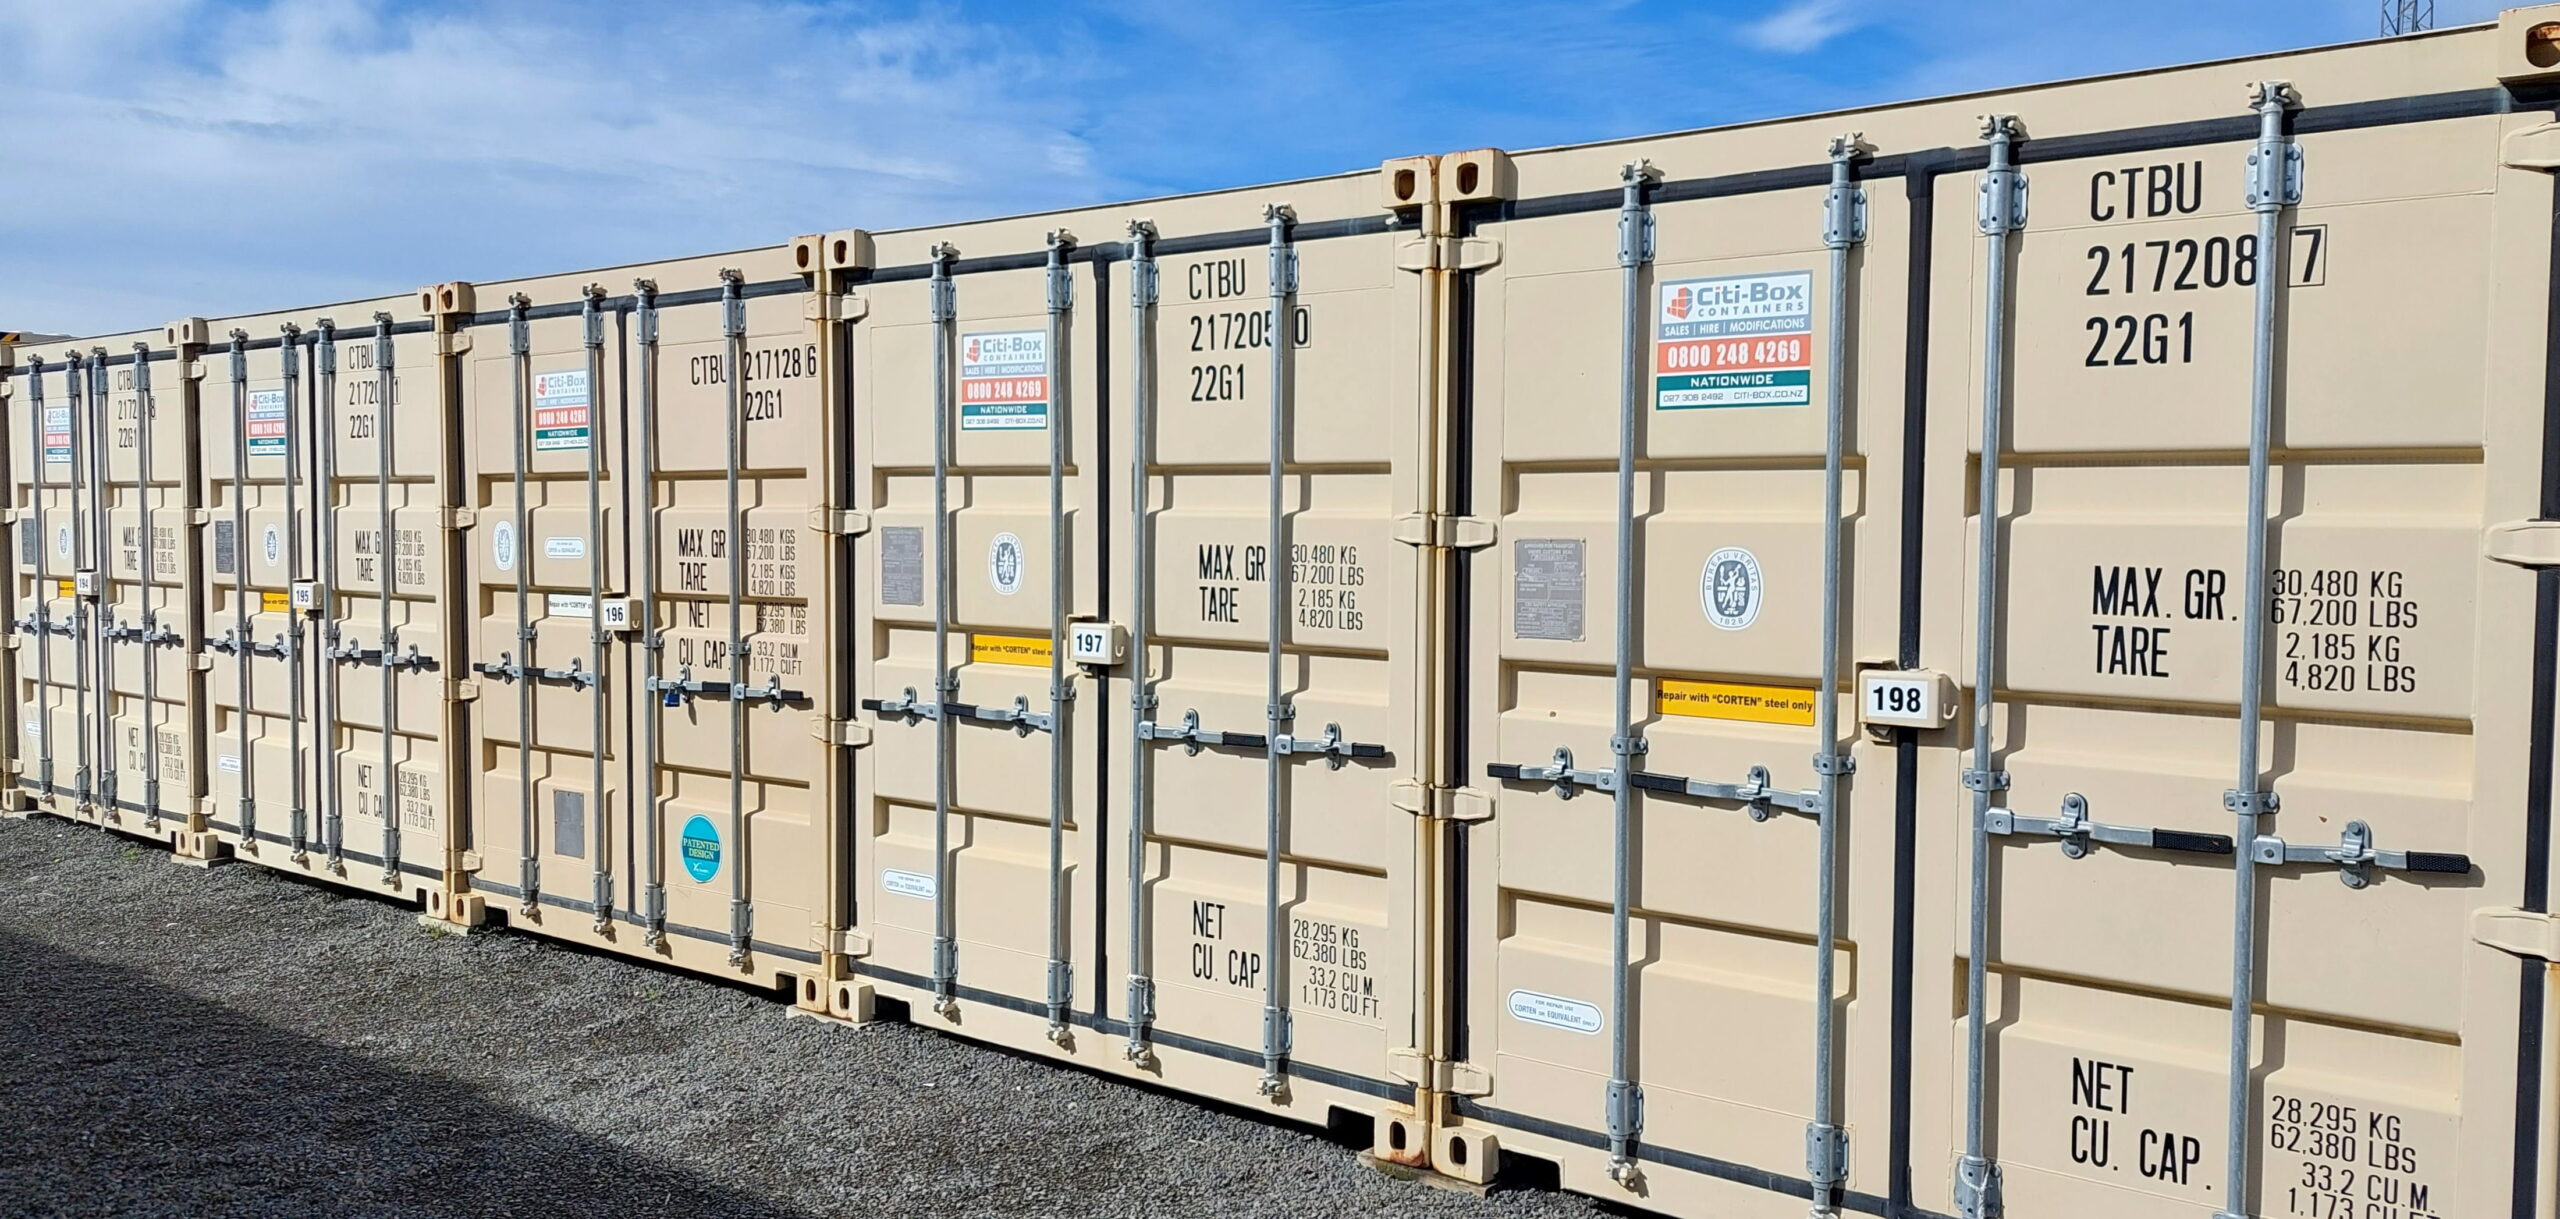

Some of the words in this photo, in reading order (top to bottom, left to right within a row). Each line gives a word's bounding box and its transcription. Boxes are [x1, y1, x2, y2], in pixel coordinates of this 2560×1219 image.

[2090, 160, 2202, 222] CTBU
[2086, 234, 2258, 296] 217208
[2295, 228, 2322, 283] 7
[1189, 258, 1246, 300] CTBU
[1697, 282, 1803, 306] Citi-Box
[1698, 302, 1804, 317] CONTAINERS
[1665, 325, 1689, 336] SALES
[1699, 323, 1719, 335] HIRE
[1729, 318, 1805, 332] MODIFICATIONS
[983, 337, 1042, 353] Citi-Box
[2085, 311, 2193, 367] 22G1
[349, 344, 374, 369] CTBU
[691, 354, 726, 385] CTBU
[744, 347, 800, 380] 217128
[807, 345, 816, 376] 6
[983, 353, 1043, 362] CONTAINERS
[1667, 344, 1711, 368] 0800
[1716, 342, 1749, 366] 248
[1755, 339, 1801, 363] 4269
[394, 379, 399, 403] 1
[548, 375, 586, 388] Citi-Box
[967, 382, 992, 399] 0800
[994, 381, 1012, 398] 248
[1016, 380, 1042, 398] 4269
[1191, 363, 1244, 402] 22G1
[1690, 374, 1774, 388] NATIONWIDE
[745, 389, 782, 421] 22G1
[1663, 394, 1680, 403] 027
[1734, 389, 1804, 400] CITI-BOX.CO.NZ
[980, 405, 1027, 414] NATIONWIDE
[350, 414, 374, 438] 22G1
[547, 429, 578, 438] NATIONWIDE
[118, 428, 137, 448] 22G1
[679, 529, 707, 557] MAX.
[780, 529, 796, 544] KGS
[123, 550, 137, 571] TARE
[414, 543, 425, 556] LBS
[780, 545, 796, 561] LBS
[1340, 546, 1357, 565] KG
[356, 558, 374, 581] TARE
[780, 564, 796, 580] KGS
[1199, 544, 1239, 581] MAX.
[1706, 553, 1729, 591] BUREAU
[1733, 552, 1758, 592] VERITAS
[414, 572, 425, 586] LBS
[679, 562, 707, 591] TARE
[1339, 566, 1364, 586] LBS
[2271, 569, 2358, 597] 30,480
[2370, 570, 2403, 598] KG
[296, 590, 309, 602] 195
[780, 581, 796, 597] LBS
[1339, 590, 1355, 609] KG
[2092, 565, 2172, 619] MAX.
[2184, 568, 2238, 622] GR.
[606, 607, 623, 621] 196
[689, 600, 711, 628] NET
[791, 603, 807, 619] KGS
[1199, 586, 1239, 623] TARE
[2271, 597, 2357, 627] 67,200
[2369, 600, 2418, 629] LBS
[790, 619, 807, 635] LBS
[1339, 611, 1363, 630] LBS
[1032, 648, 1046, 656] steel
[1076, 633, 1102, 652] 197
[2092, 624, 2171, 678] TARE
[2286, 631, 2355, 661] 2,185
[2368, 633, 2400, 662] KG
[2285, 661, 2355, 692] 4,820
[2367, 664, 2416, 693] LBS
[1657, 689, 1686, 701] Repair
[1689, 692, 1709, 703] with
[1764, 698, 1789, 709] steel
[1791, 701, 1813, 713] only
[1873, 686, 1921, 712] 198
[128, 727, 138, 748] NET
[358, 763, 372, 789] NET
[420, 787, 430, 801] LBS
[683, 837, 719, 851] PATENTED
[688, 847, 714, 860] DESIGN
[1193, 900, 1225, 940] NET
[1342, 927, 1358, 948] KG
[1193, 943, 1218, 982] CU.
[1228, 949, 1266, 991] CAP.
[1342, 948, 1367, 970] LBS
[1309, 965, 1336, 989] 33.2
[1514, 1003, 1537, 1015] CORTEN
[1547, 1010, 1581, 1024] EQUIVALENT
[2072, 1057, 2134, 1115] NET
[2369, 1111, 2401, 1143] KG
[2071, 1114, 2119, 1171] CU.
[2139, 1128, 2212, 1191] CAP.
[2368, 1140, 2416, 1174] LBS
[2302, 1162, 2355, 1196] 33.2
[2367, 1174, 2435, 1214] CU.M.
